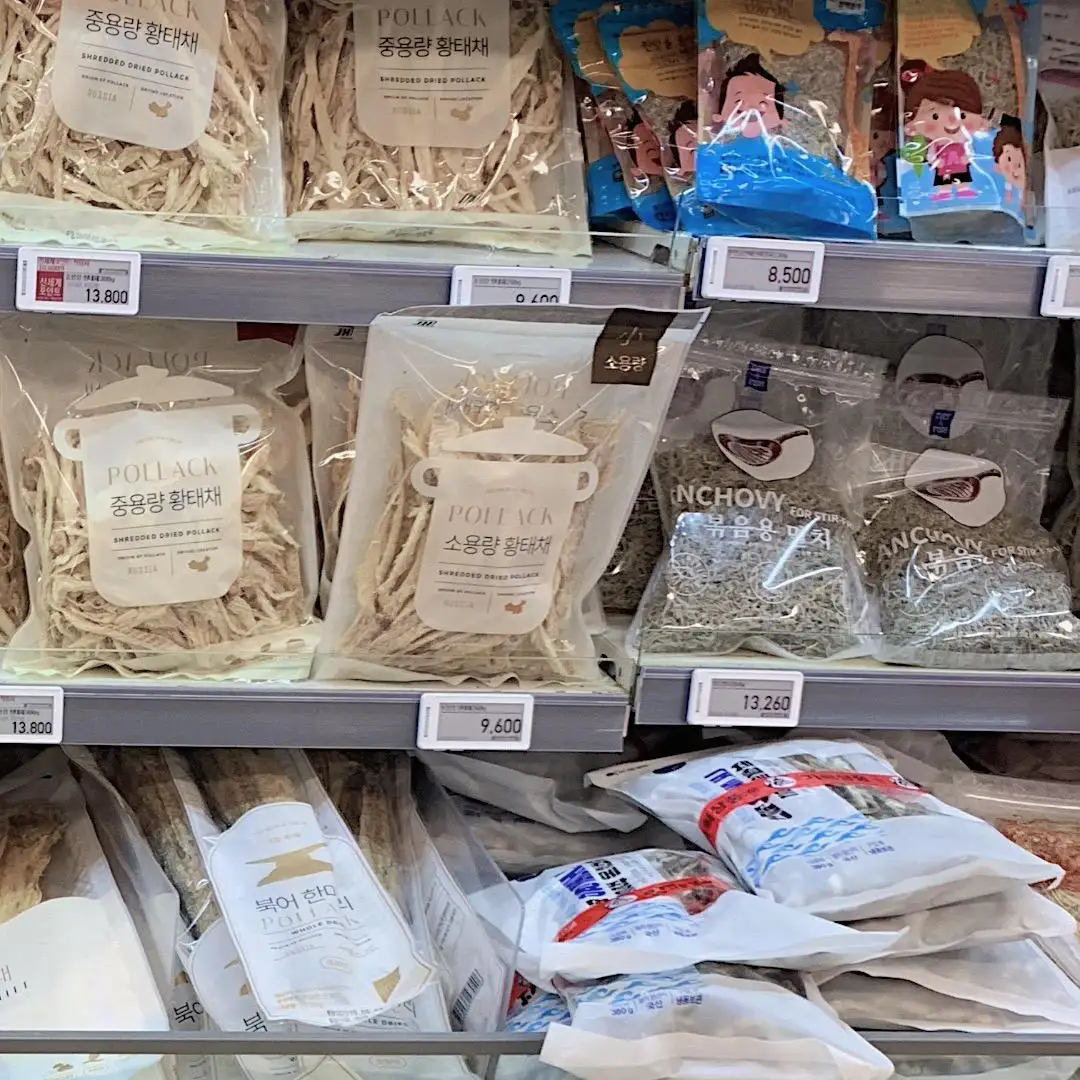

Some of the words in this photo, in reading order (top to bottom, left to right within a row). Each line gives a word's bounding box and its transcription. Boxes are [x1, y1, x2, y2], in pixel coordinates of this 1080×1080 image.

[377, 8, 487, 28] POLLACK
[84, 8, 141, 40] 중용량
[144, 21, 200, 54] 황태채
[378, 36, 433, 58] 중용량
[435, 36, 489, 57] 황태채
[81, 51, 125, 67] SHREDDED
[127, 61, 152, 74] DRIED
[154, 67, 190, 82] POLLACK
[379, 75, 421, 84] SHREDDED
[423, 76, 448, 84] DRIED
[450, 76, 487, 84] POLLACK
[767, 266, 811, 284] 8,500
[85, 287, 128, 304] 13,800
[603, 355, 647, 372] 소용량
[107, 457, 218, 486] POLLACK
[109, 491, 165, 518] 중용량
[168, 485, 223, 512] 황태채
[448, 503, 553, 526] POLLACK
[113, 533, 157, 544] SHREDDED
[159, 530, 184, 540] DRIED
[185, 527, 221, 537] POLLACK
[442, 534, 501, 557] 소용량
[502, 535, 553, 557] 황태채
[438, 568, 482, 579] SHREDDED
[484, 572, 508, 581] DRIED
[510, 571, 540, 580] POLLACK
[743, 694, 790, 711] 13,260
[12, 720, 53, 735] 13,800
[480, 718, 522, 735] 9,600
[255, 893, 300, 914] 북어
[260, 902, 360, 931] POLLAK
